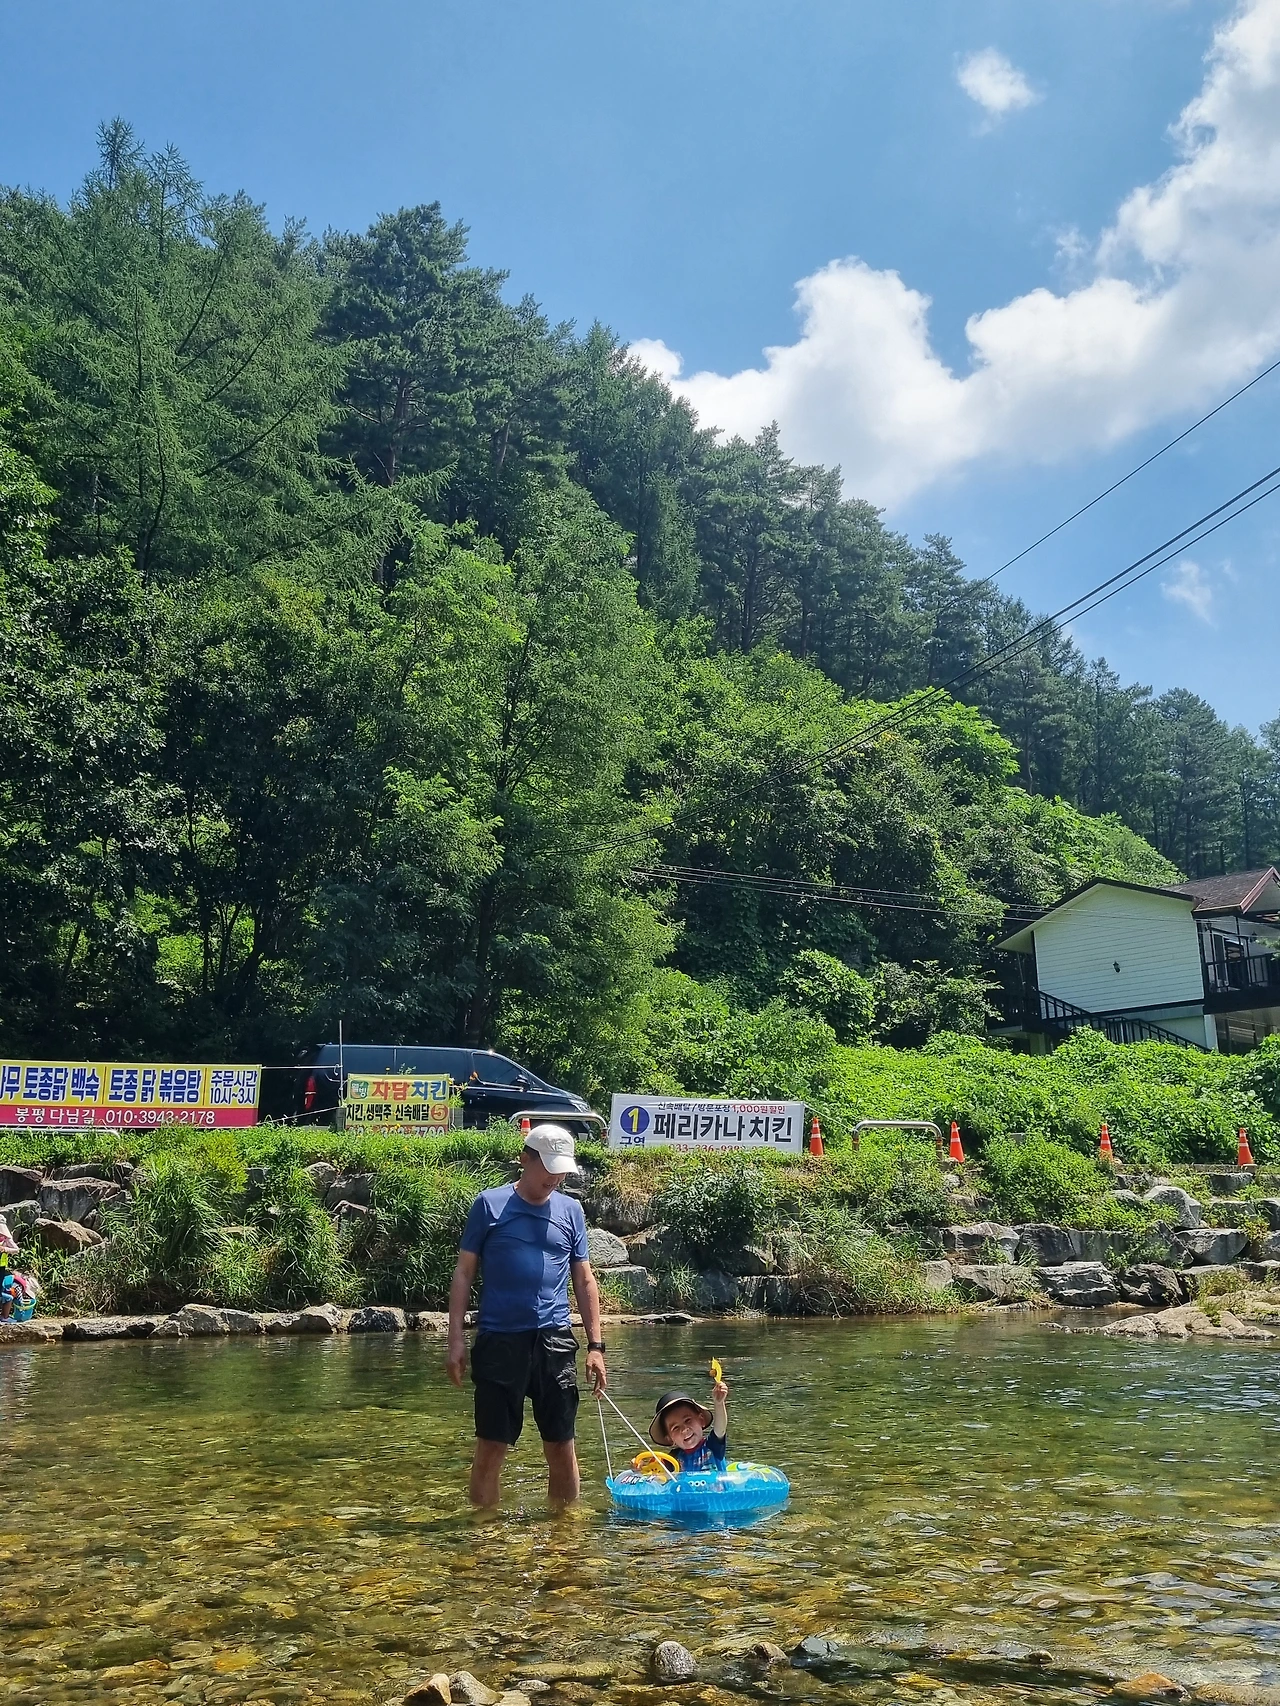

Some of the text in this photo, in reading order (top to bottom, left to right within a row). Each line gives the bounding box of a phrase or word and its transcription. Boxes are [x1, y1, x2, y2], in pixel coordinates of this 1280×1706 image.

[22, 1067, 68, 1101] 토종닭
[71, 1068, 99, 1102] 백숙
[108, 1069, 138, 1102] 토종
[159, 1069, 201, 1103] 볶음탕
[211, 1070, 258, 1087] 주문시간
[210, 1087, 256, 1104] 10시~3시
[371, 1080, 447, 1101] 자담치킨
[15, 1107, 45, 1123] 봉평
[50, 1108, 95, 1124] 다님길
[395, 1103, 430, 1121] 신속배달
[627, 1107, 639, 1133] 1
